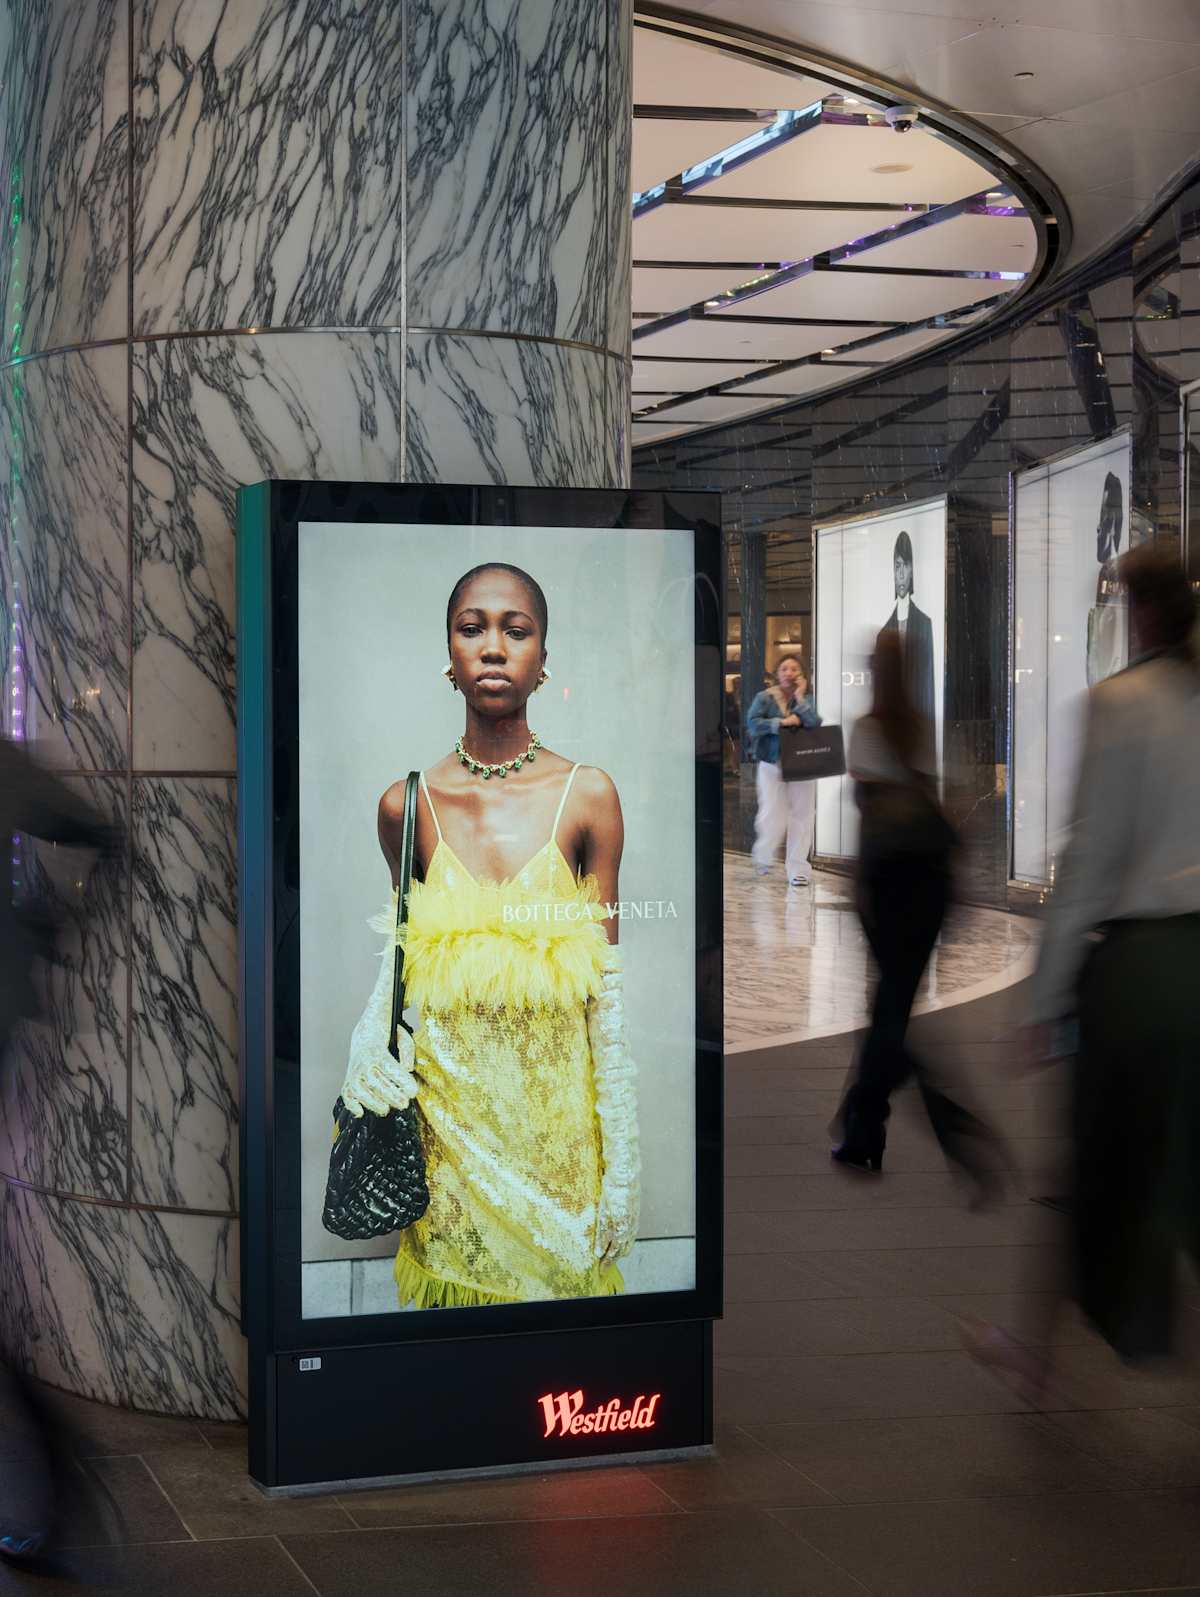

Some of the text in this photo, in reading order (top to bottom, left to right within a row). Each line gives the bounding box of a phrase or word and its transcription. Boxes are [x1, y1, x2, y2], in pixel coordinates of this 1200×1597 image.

[503, 900, 678, 923] BOTTEGA VENETA
[538, 1389, 661, 1438] Westfield
